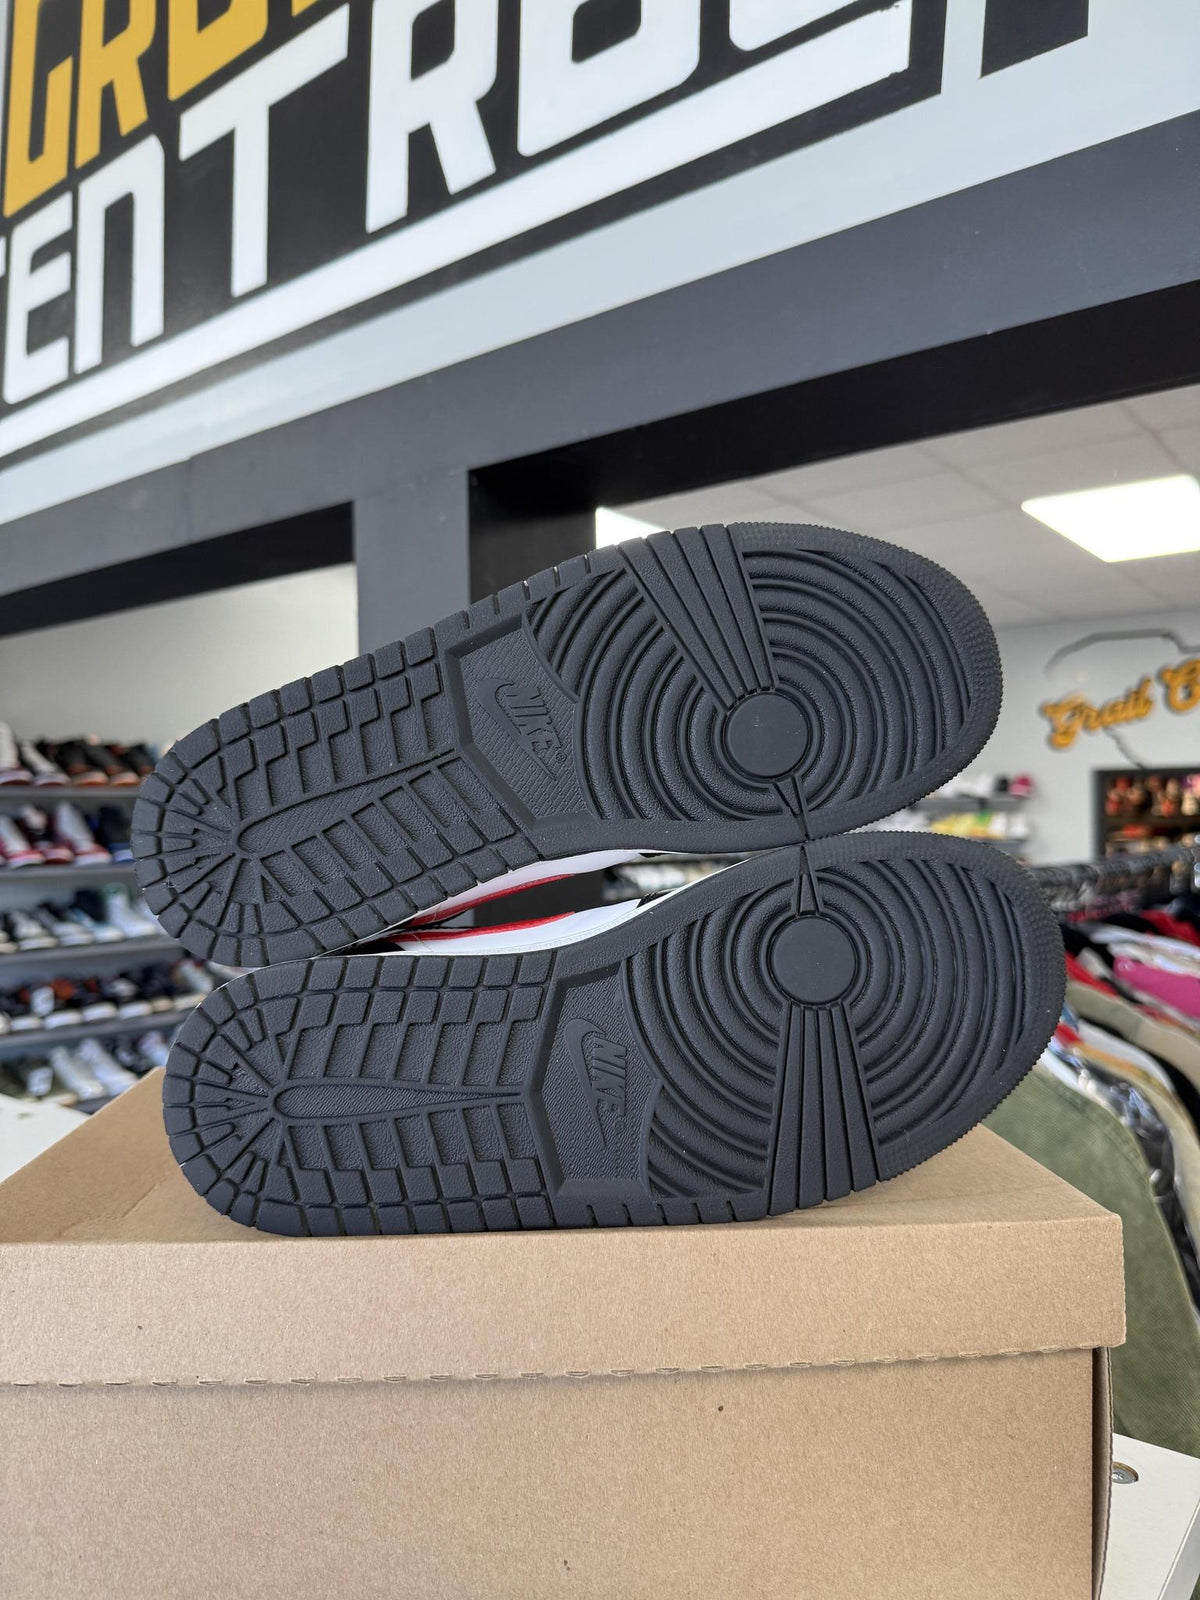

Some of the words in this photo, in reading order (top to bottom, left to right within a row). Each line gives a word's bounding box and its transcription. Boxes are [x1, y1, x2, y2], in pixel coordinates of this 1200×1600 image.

[504, 685, 563, 750] NIKE
[1042, 677, 1154, 749] Grail
[590, 1035, 628, 1118] NIKE
